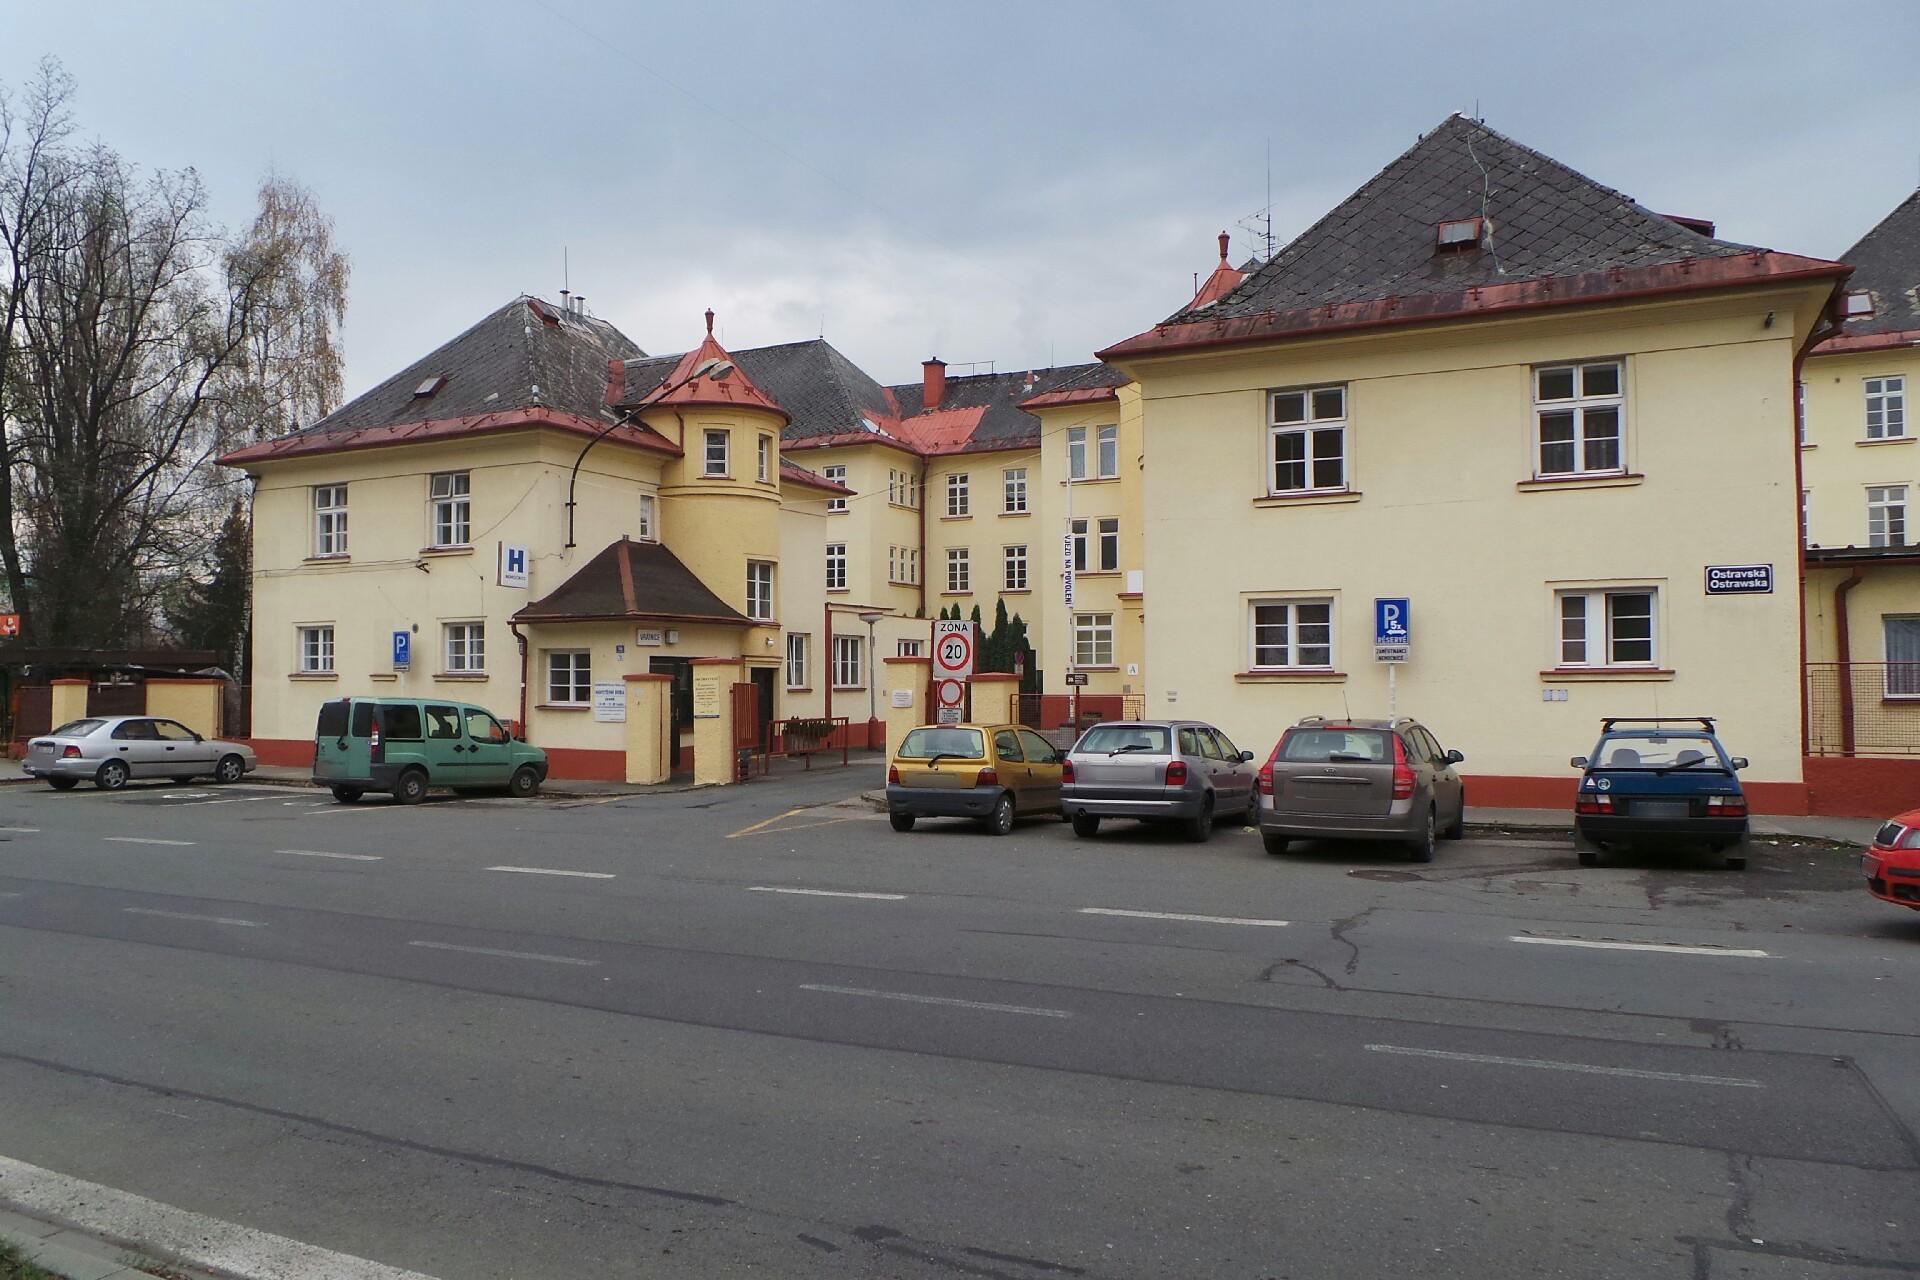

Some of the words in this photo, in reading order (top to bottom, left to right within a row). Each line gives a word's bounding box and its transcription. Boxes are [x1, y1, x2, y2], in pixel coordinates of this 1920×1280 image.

[508, 549, 524, 573] H
[1065, 559, 1072, 569] NA
[1711, 568, 1766, 579] Ostravská
[1710, 578, 1768, 589] Ostrawska
[1383, 604, 1400, 629] P
[940, 621, 968, 632] ZÓNA
[1390, 620, 1402, 630] 5x
[396, 635, 406, 654] P
[945, 644, 962, 660] 20
[1130, 665, 1136, 673] A
